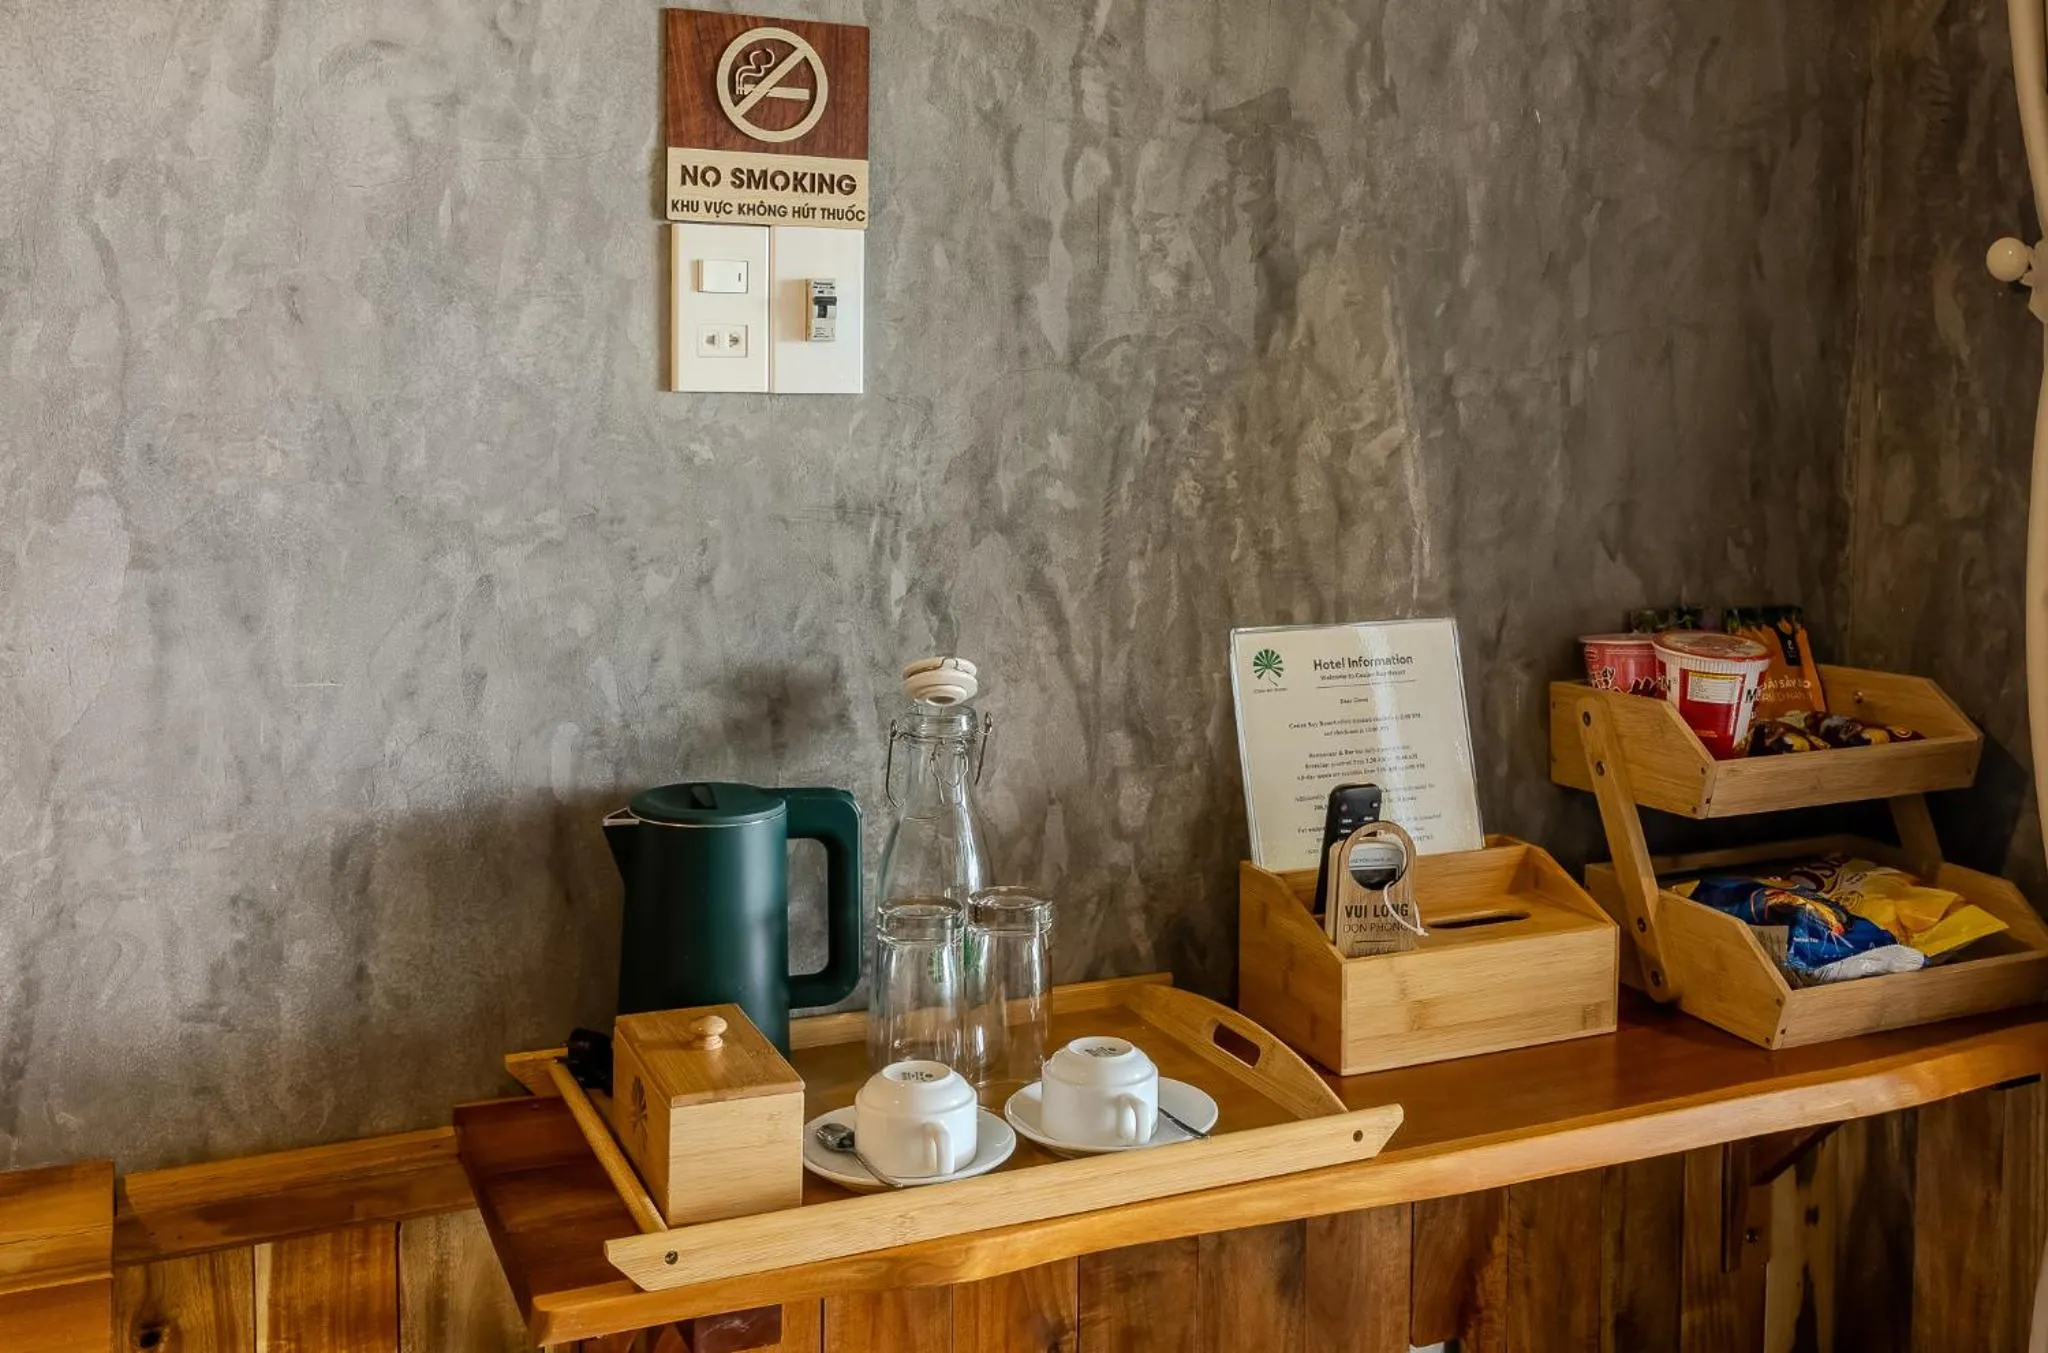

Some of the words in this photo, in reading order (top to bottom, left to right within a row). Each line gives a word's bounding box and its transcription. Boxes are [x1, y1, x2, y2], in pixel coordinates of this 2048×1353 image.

[680, 164, 722, 188] NO
[730, 167, 857, 195] SMOKING
[671, 199, 699, 213] KHU
[704, 200, 733, 218] VỰC
[738, 200, 788, 218] KHÔNG
[792, 202, 817, 219] HÚT
[820, 204, 866, 222] THUỐC
[1313, 657, 1345, 672] Hotel
[1348, 654, 1414, 669] Information
[1345, 905, 1367, 918] VUI
